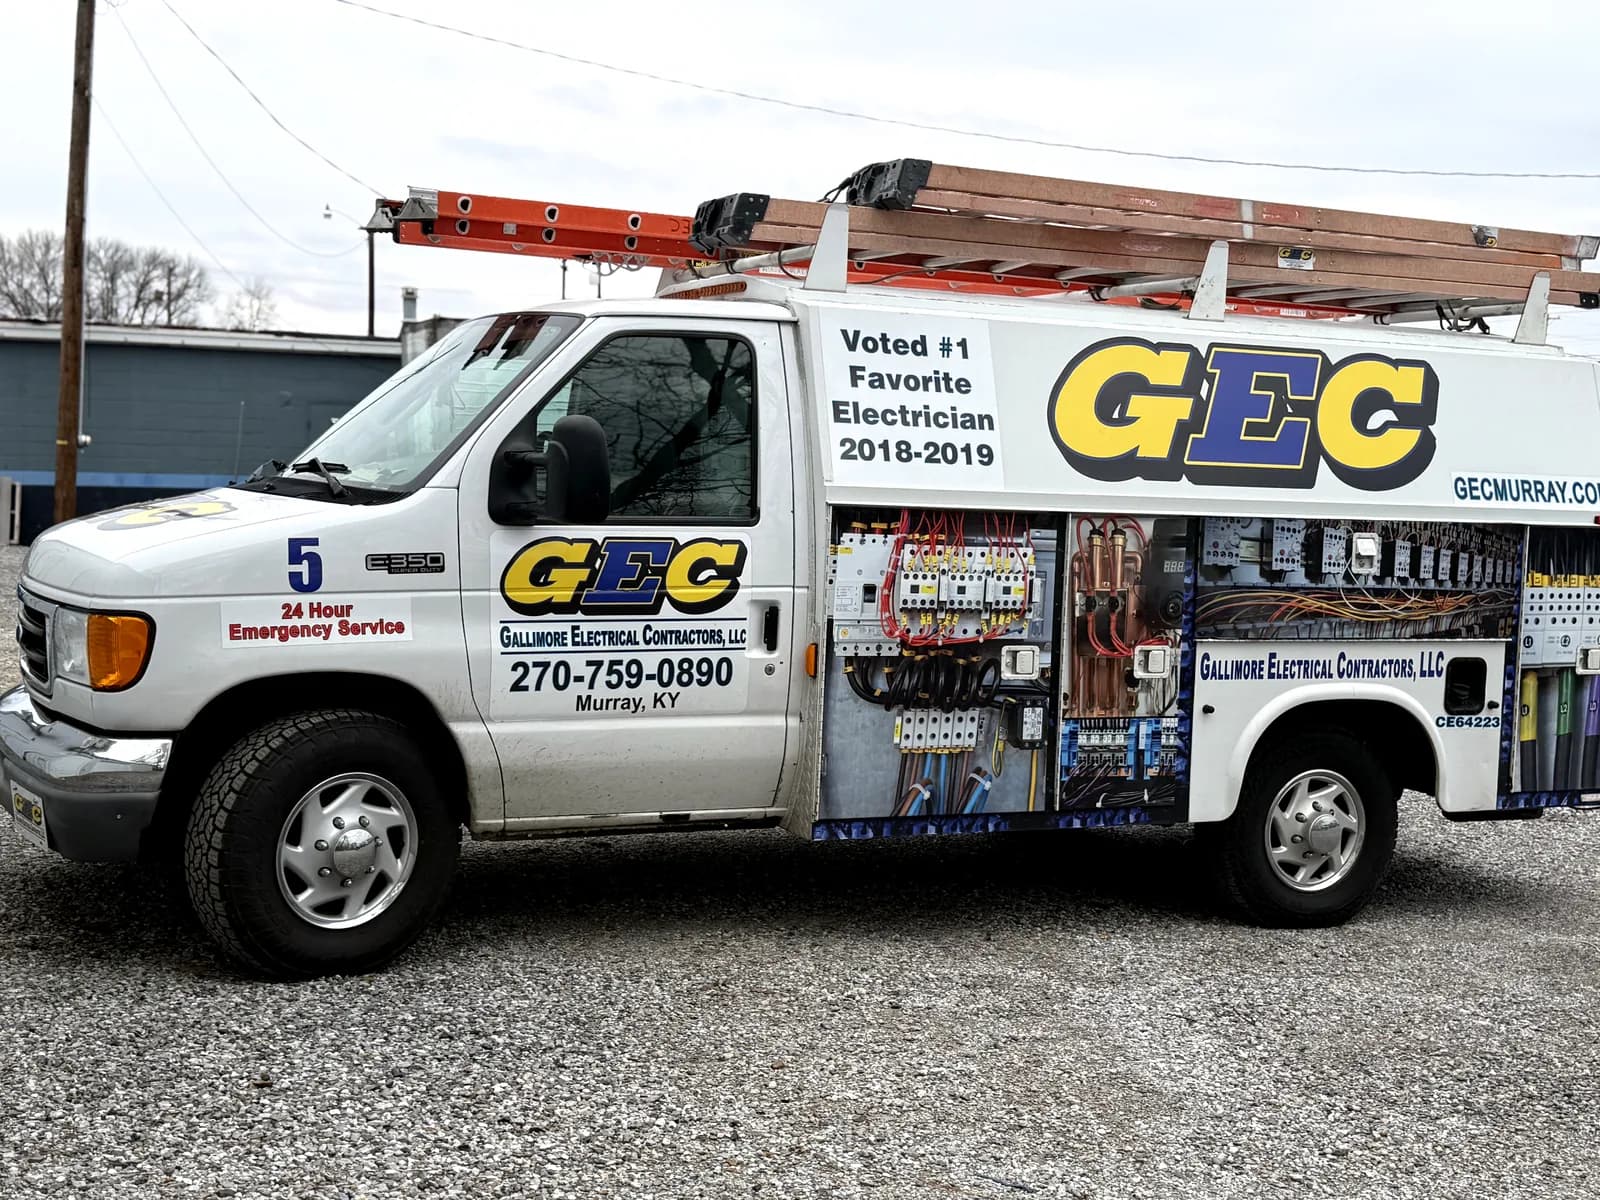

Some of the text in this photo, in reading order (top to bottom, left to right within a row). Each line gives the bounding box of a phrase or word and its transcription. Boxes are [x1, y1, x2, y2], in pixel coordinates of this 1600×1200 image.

[840, 329, 969, 360] Voted #1
[848, 365, 972, 395] Favorite
[832, 400, 995, 431] Electrician
[1047, 336, 1440, 492] GEC
[839, 437, 994, 467] 2018-2019
[1453, 476, 1600, 505] GECMURRAY.CO
[287, 537, 323, 593] 5
[500, 536, 748, 617] GEC
[281, 601, 354, 620] 24 Hour
[228, 618, 405, 643] Emergency Service
[500, 624, 747, 648] GALLIMORE ELECTRICAL CONTRACTORS, LLC
[509, 656, 733, 693] 270-759-0890
[1200, 651, 1445, 682] GALLIMORE ELECTRICAL CONTRACTORS, LLC
[575, 691, 681, 714] Murray, KY
[1435, 716, 1500, 728] CE64223
